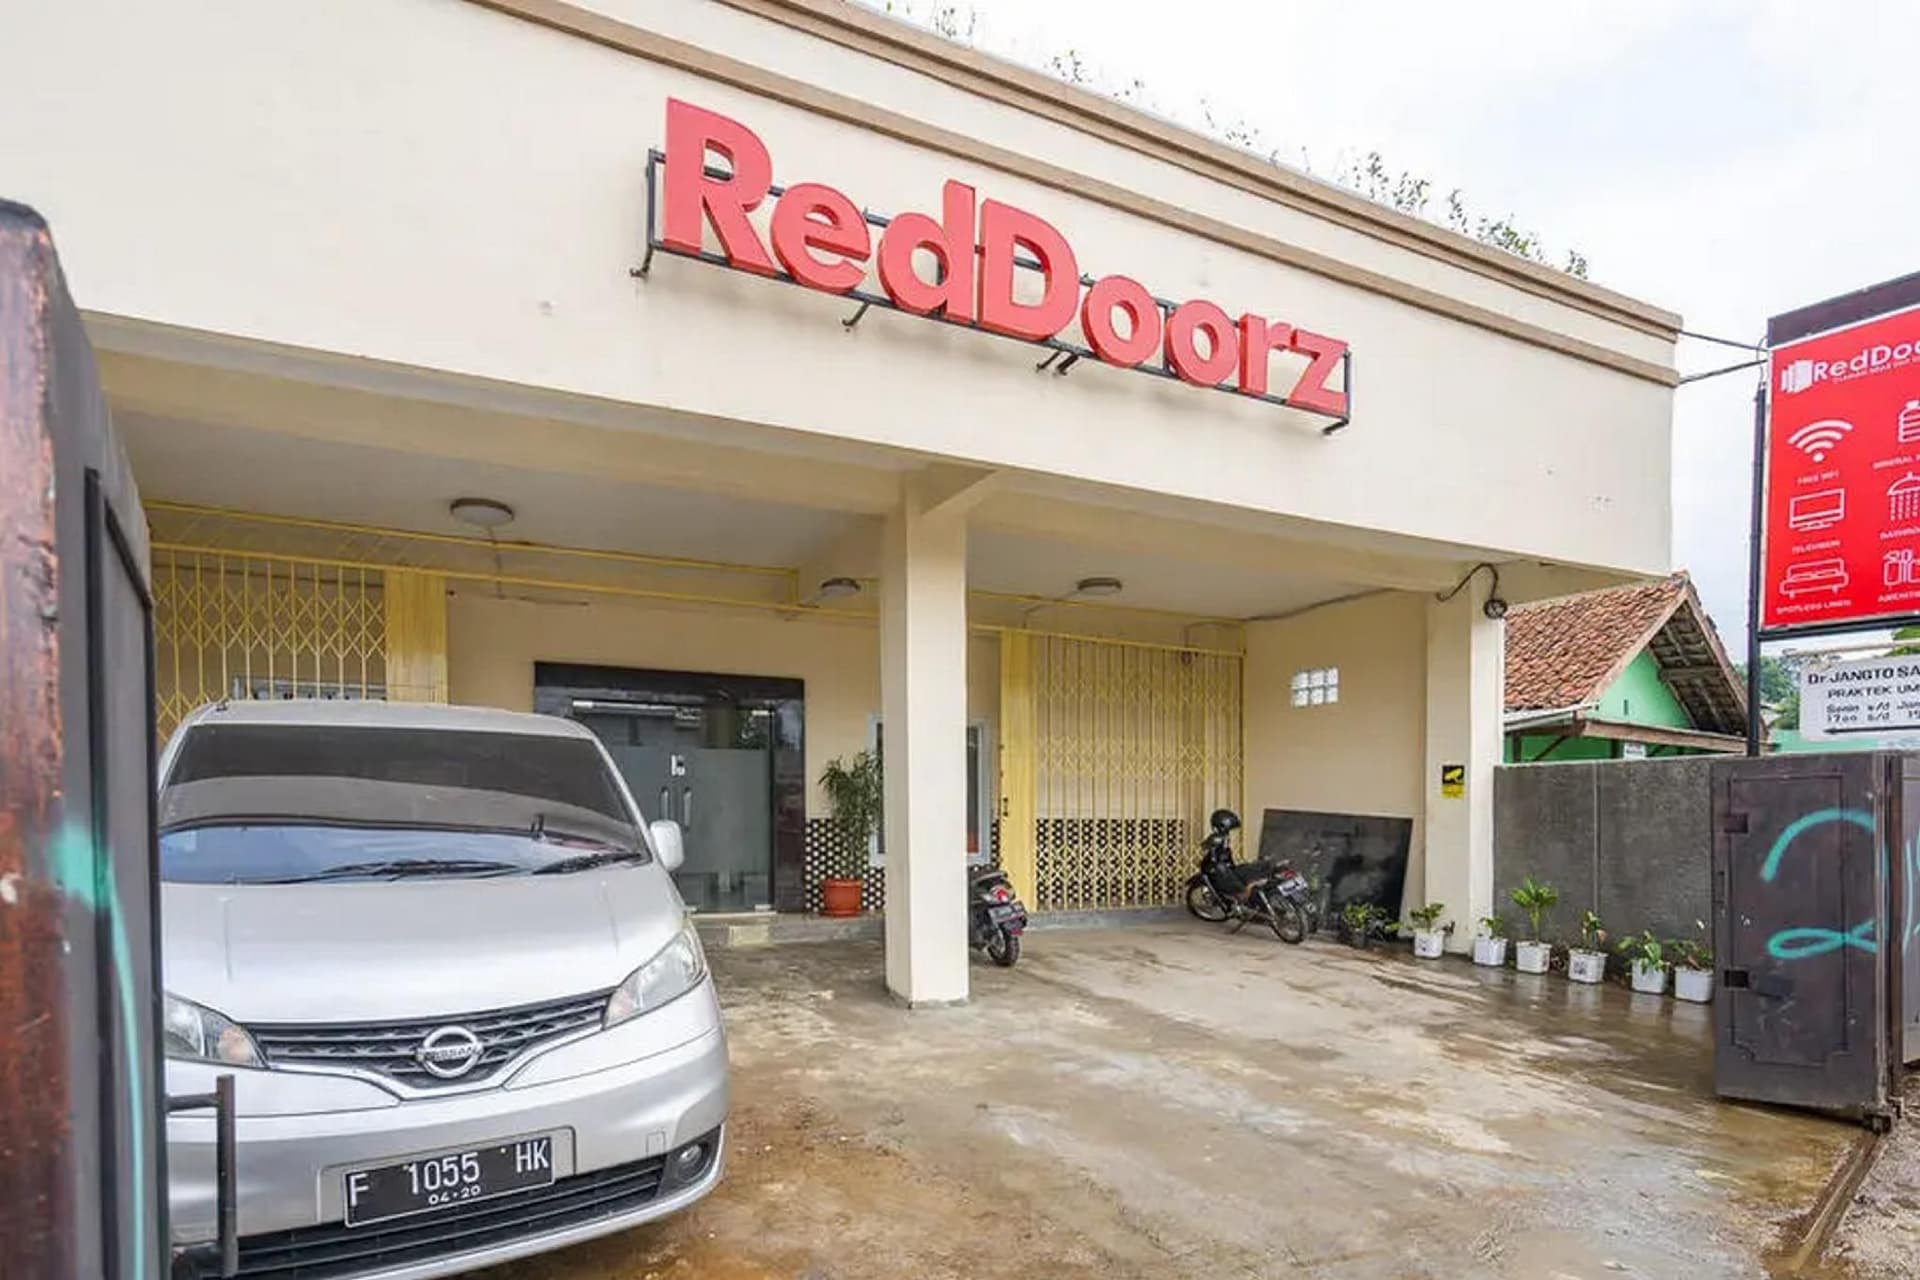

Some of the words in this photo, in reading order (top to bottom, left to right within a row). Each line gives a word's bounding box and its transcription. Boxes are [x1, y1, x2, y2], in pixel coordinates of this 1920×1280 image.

[664, 97, 1350, 416] RedDoorz
[1814, 341, 1920, 382] RedDo
[1828, 686, 1892, 699] PRAKTEK
[349, 1173, 369, 1206] F
[408, 1152, 480, 1194] 1055
[515, 1139, 549, 1173] HK
